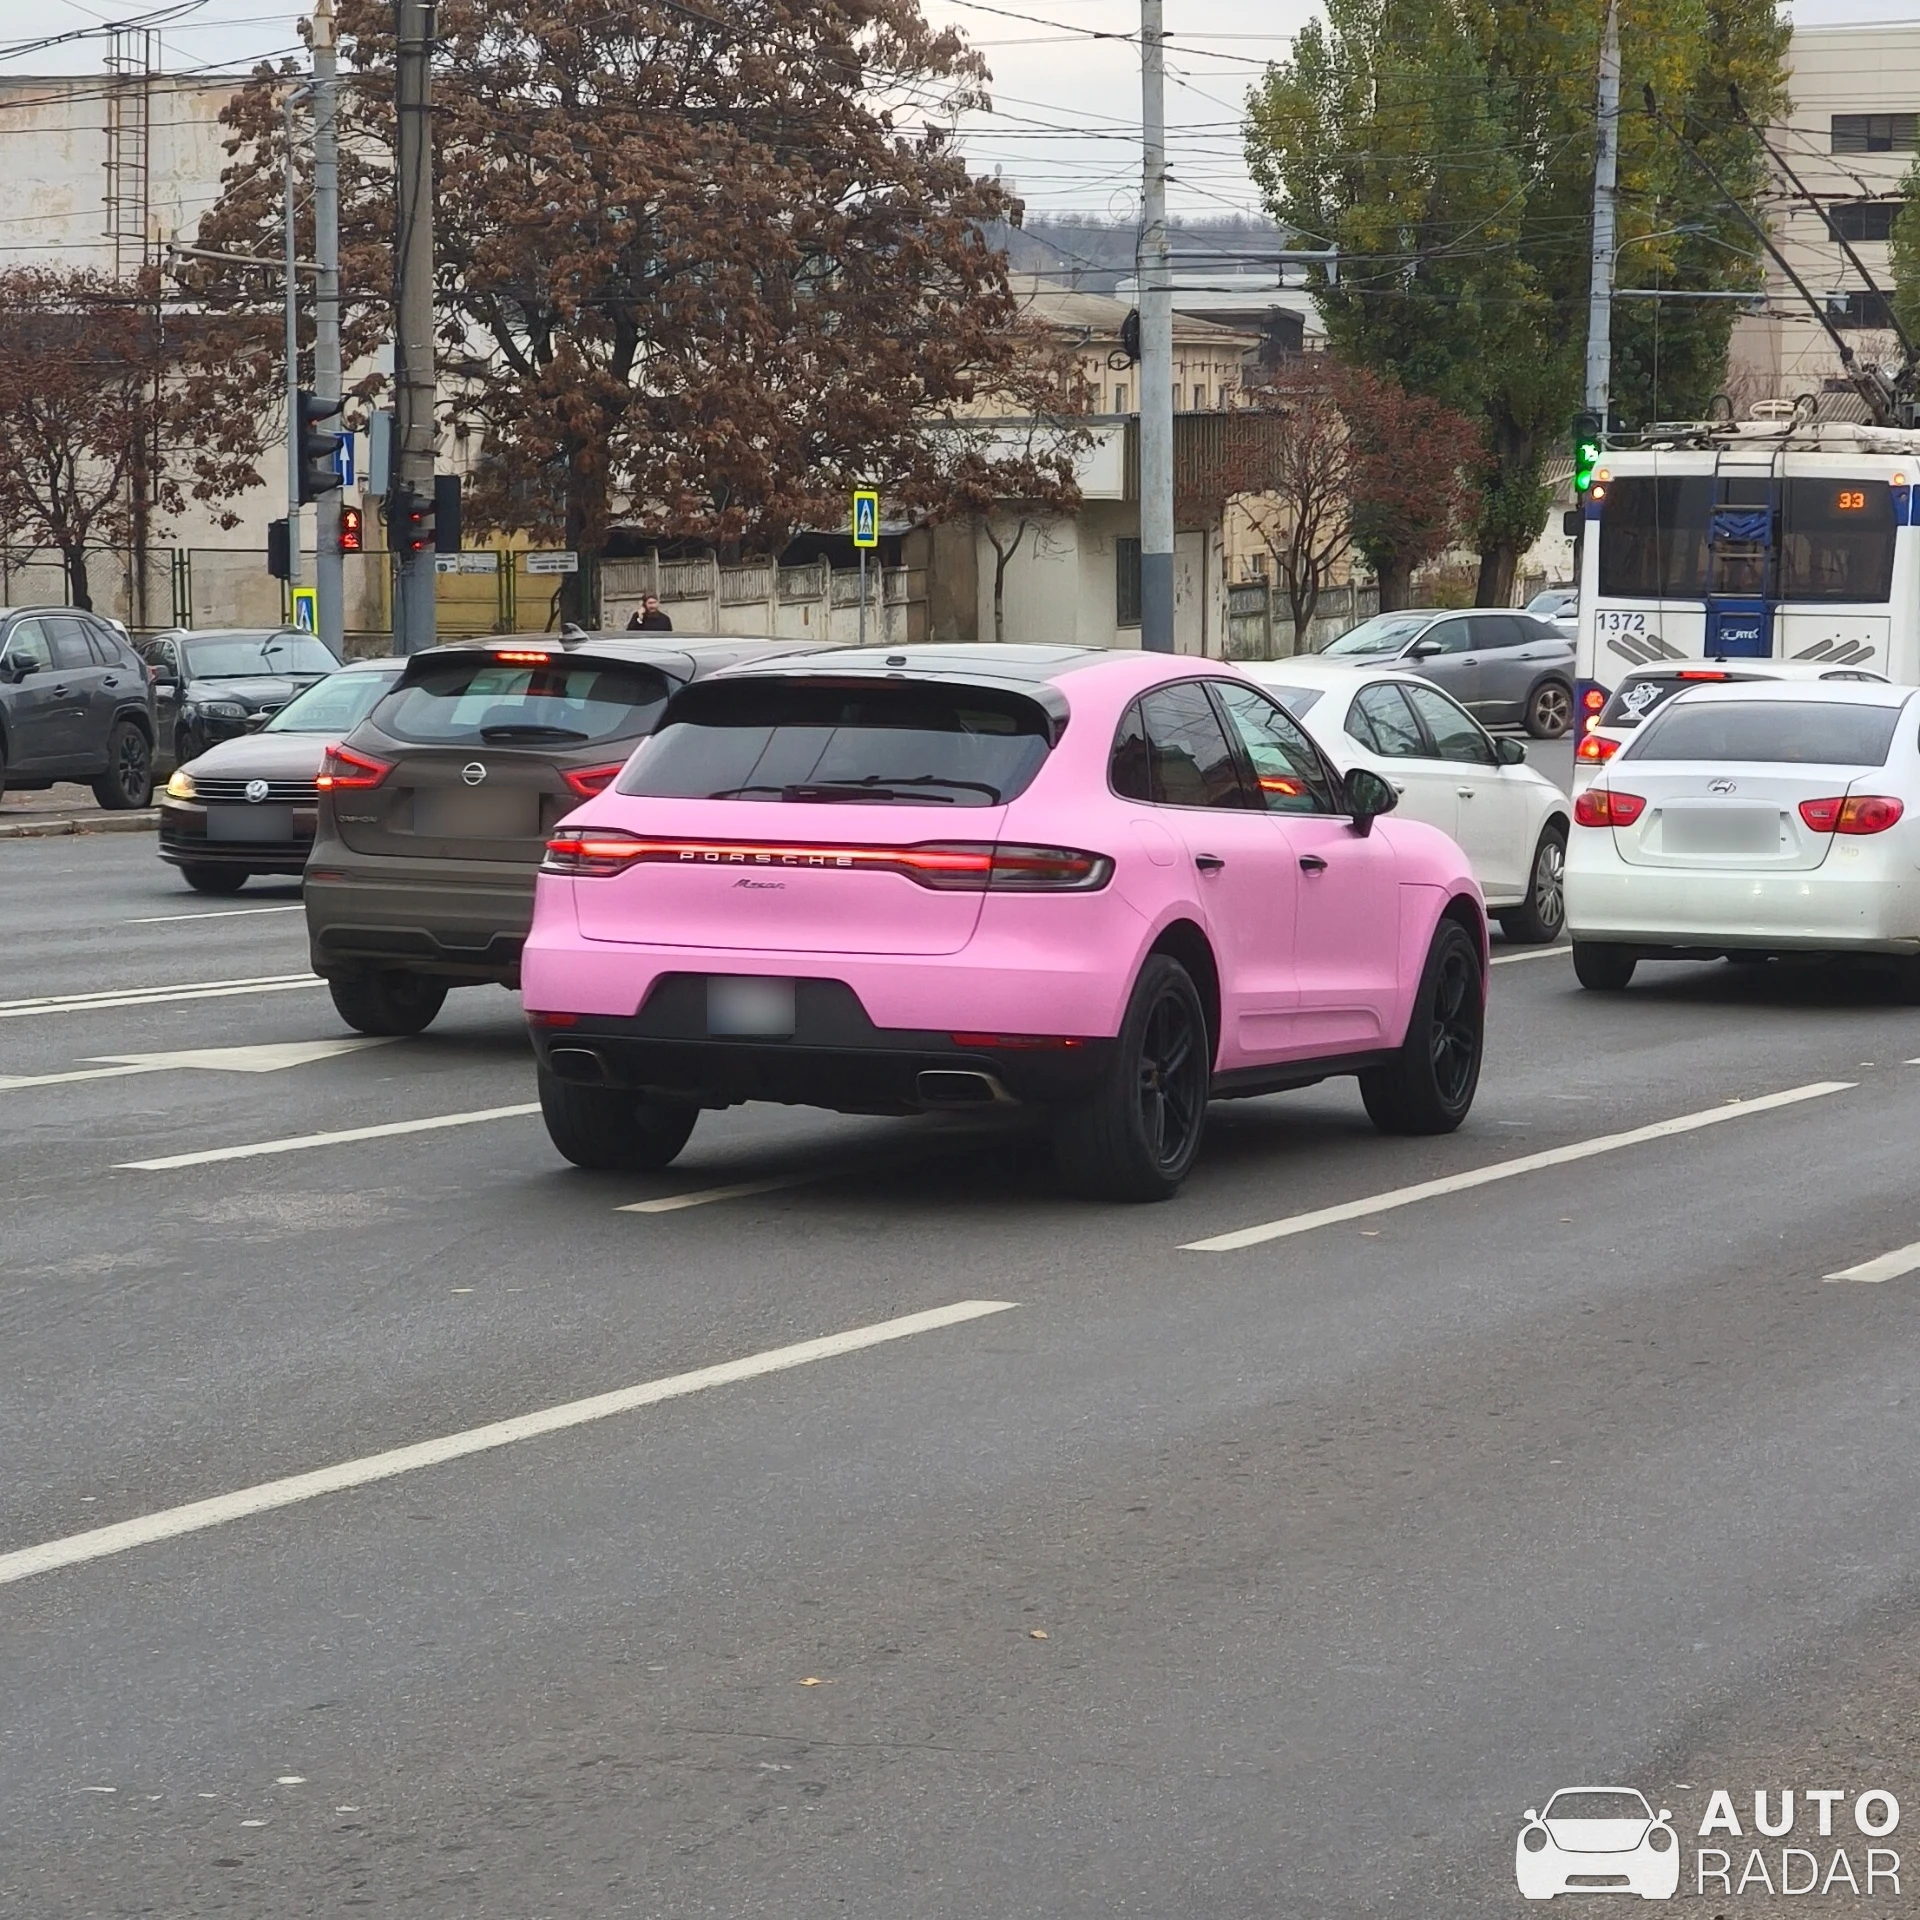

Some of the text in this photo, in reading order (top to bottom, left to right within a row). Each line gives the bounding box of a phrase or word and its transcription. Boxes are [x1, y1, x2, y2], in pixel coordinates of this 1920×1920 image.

[1839, 492, 1864, 508] 33
[1598, 613, 1645, 631] 1372
[679, 851, 853, 867] PORSCHE
